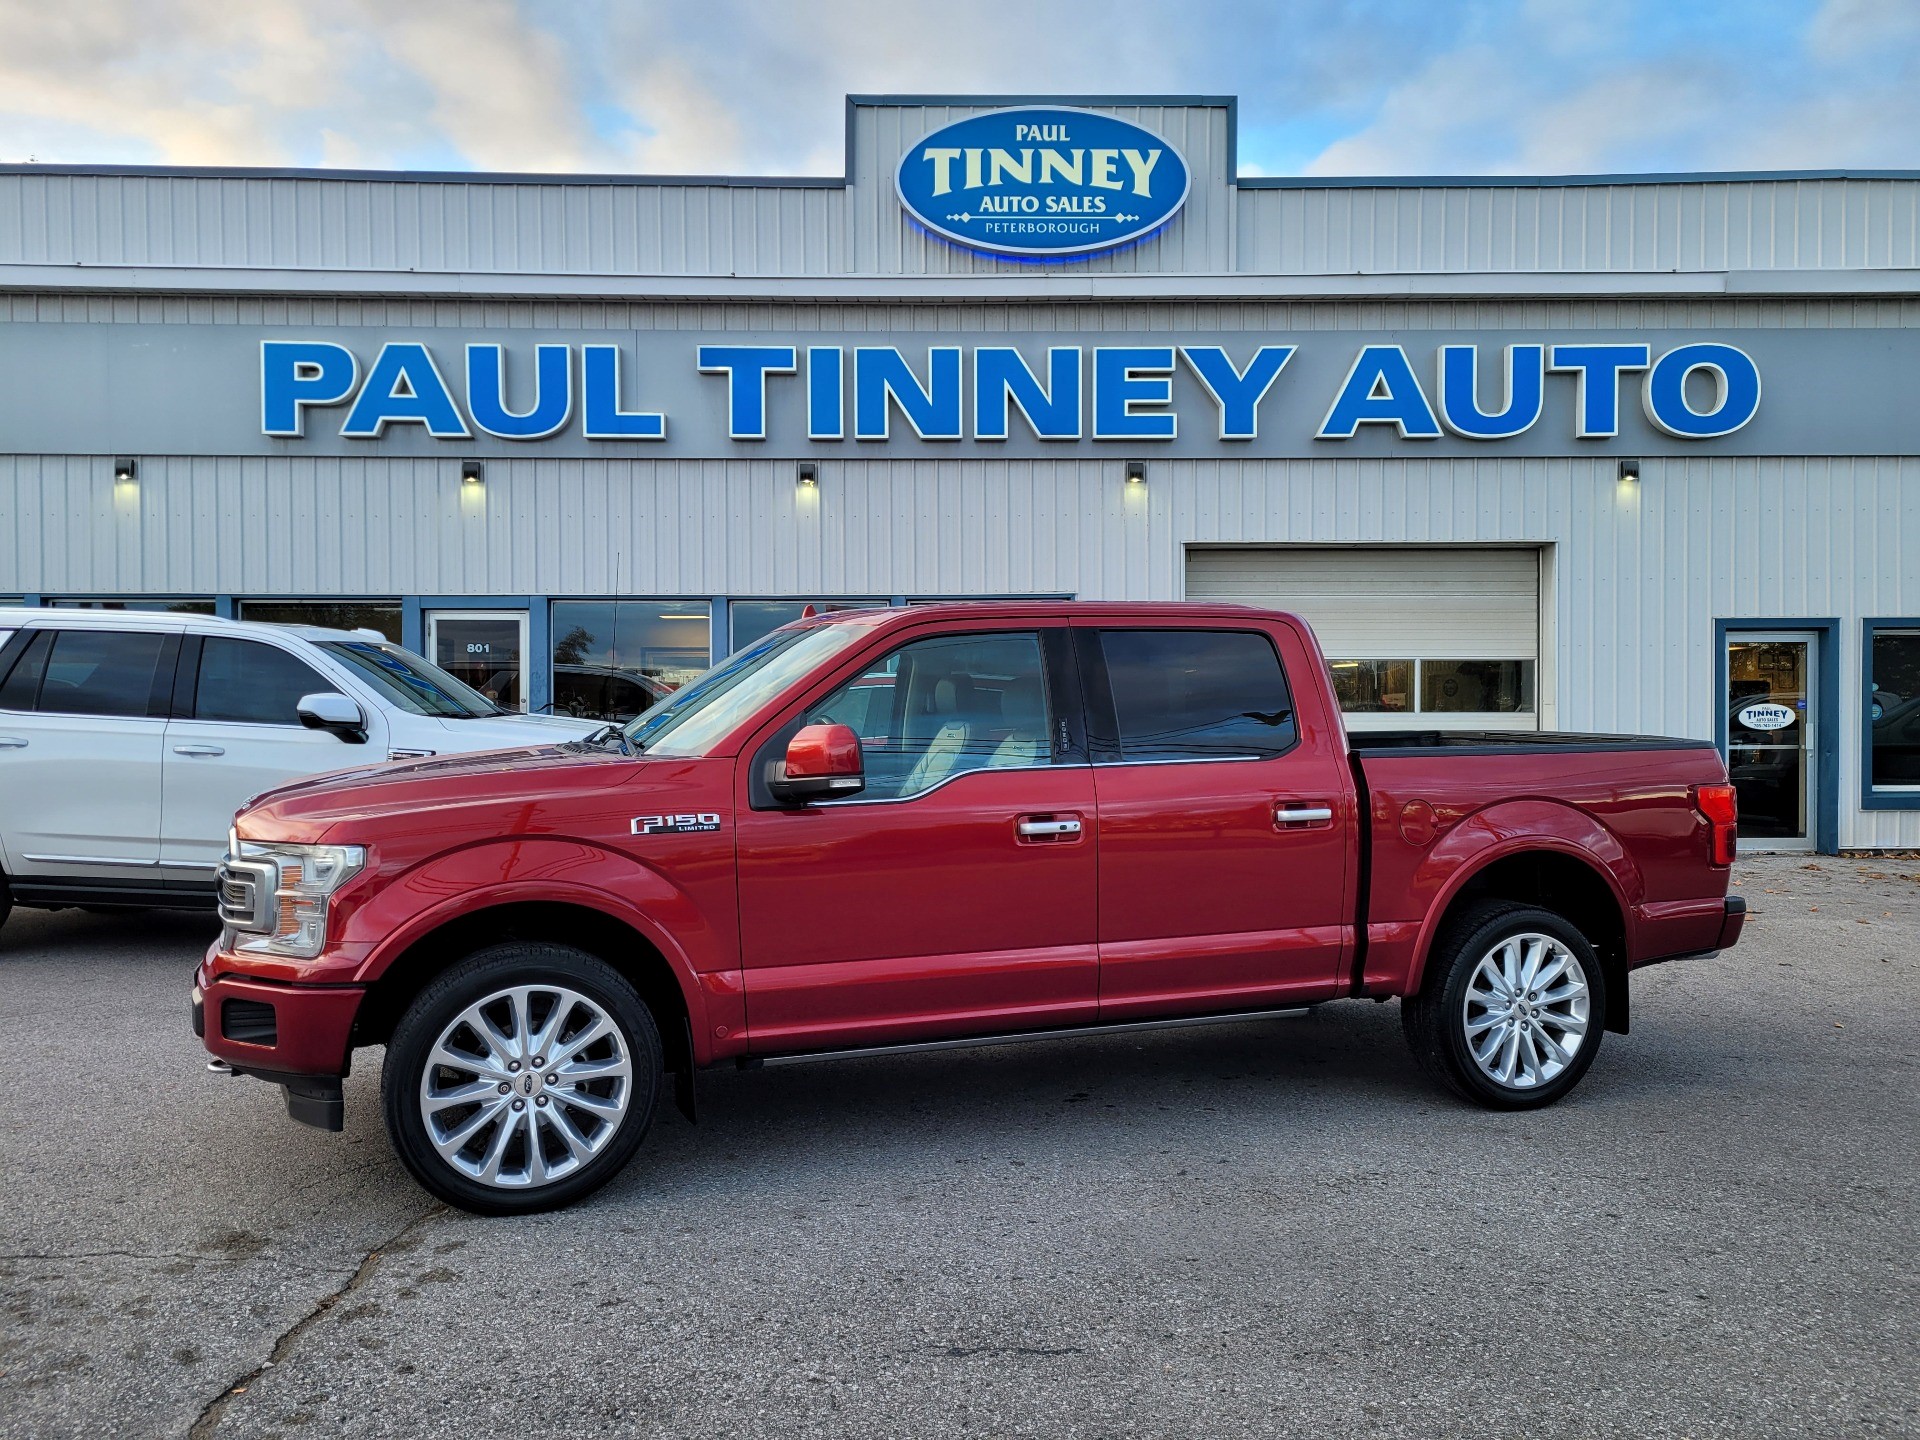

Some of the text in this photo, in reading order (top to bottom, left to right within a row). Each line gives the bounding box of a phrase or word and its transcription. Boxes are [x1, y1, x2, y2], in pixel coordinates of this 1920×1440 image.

[1016, 124, 1071, 141] PAUL
[923, 148, 1162, 198] TINNEY
[979, 196, 1106, 213] AUTO SALES
[985, 222, 1100, 234] PETERBOROUGH
[260, 340, 1762, 440] PAUL TINNEY AUTO
[466, 643, 490, 653] 801
[1746, 710, 1788, 719] TINNEY
